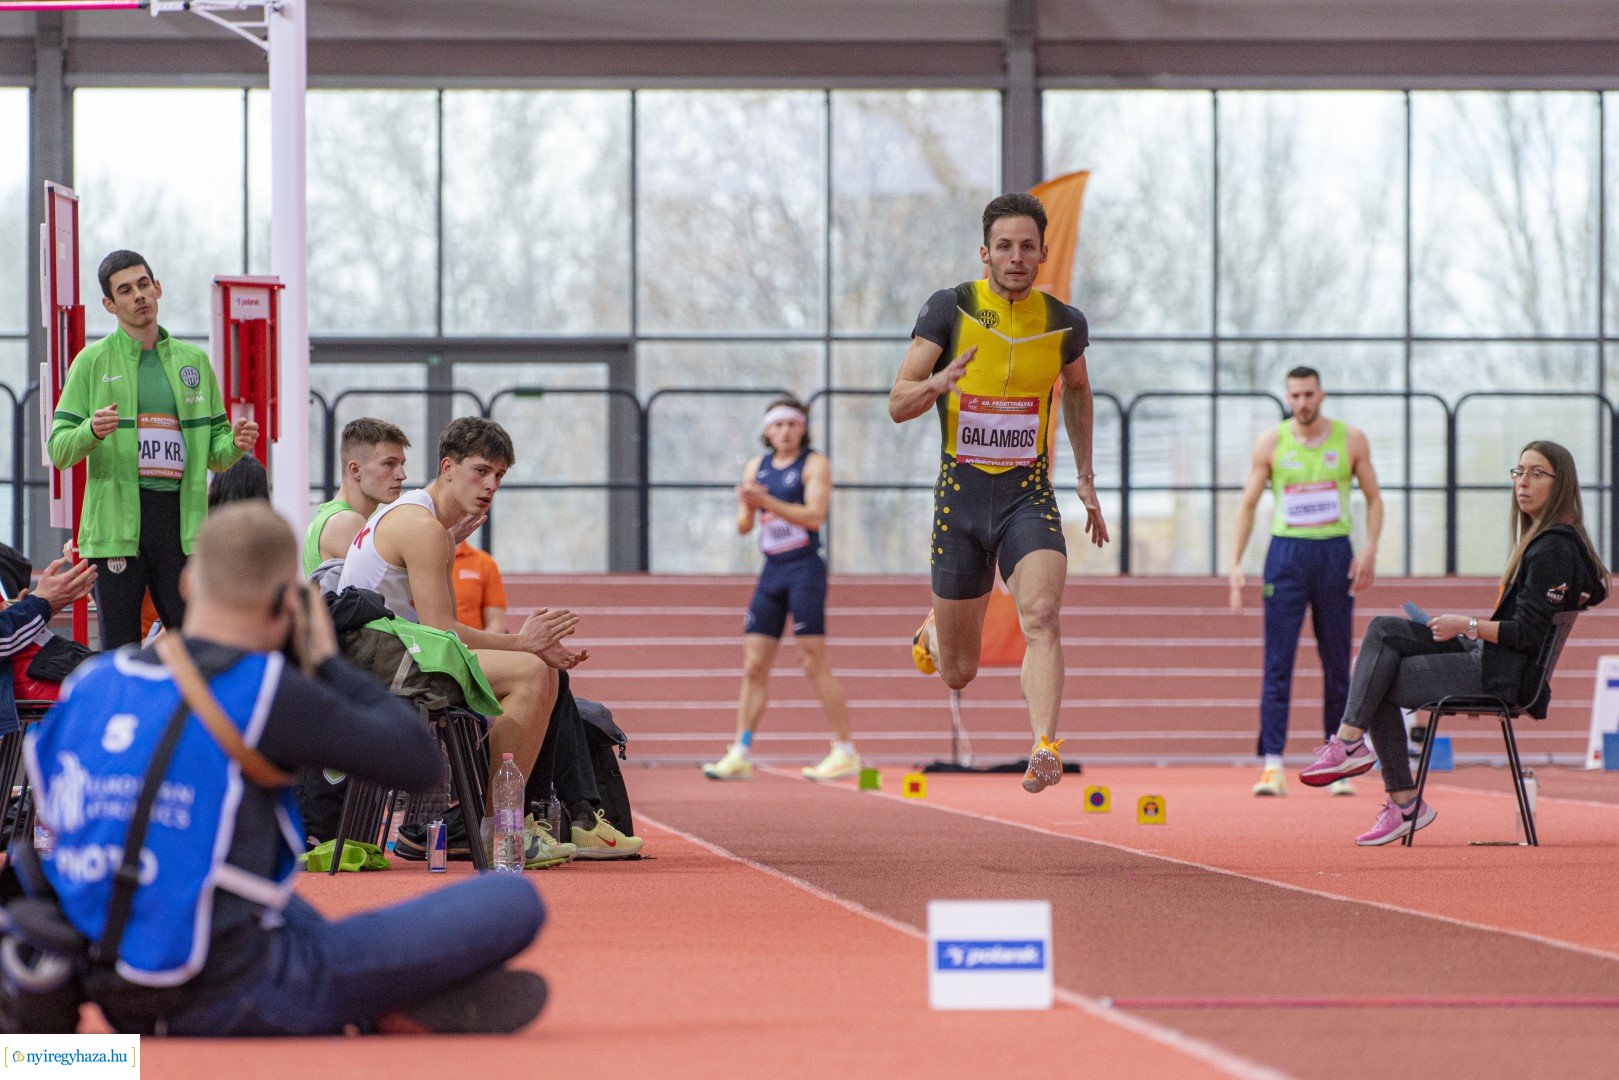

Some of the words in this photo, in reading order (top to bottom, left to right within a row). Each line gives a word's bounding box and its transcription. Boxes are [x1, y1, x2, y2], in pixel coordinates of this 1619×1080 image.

[962, 427, 1035, 448] GALAMBOS
[165, 441, 184, 463] KR.
[102, 713, 139, 753] 5
